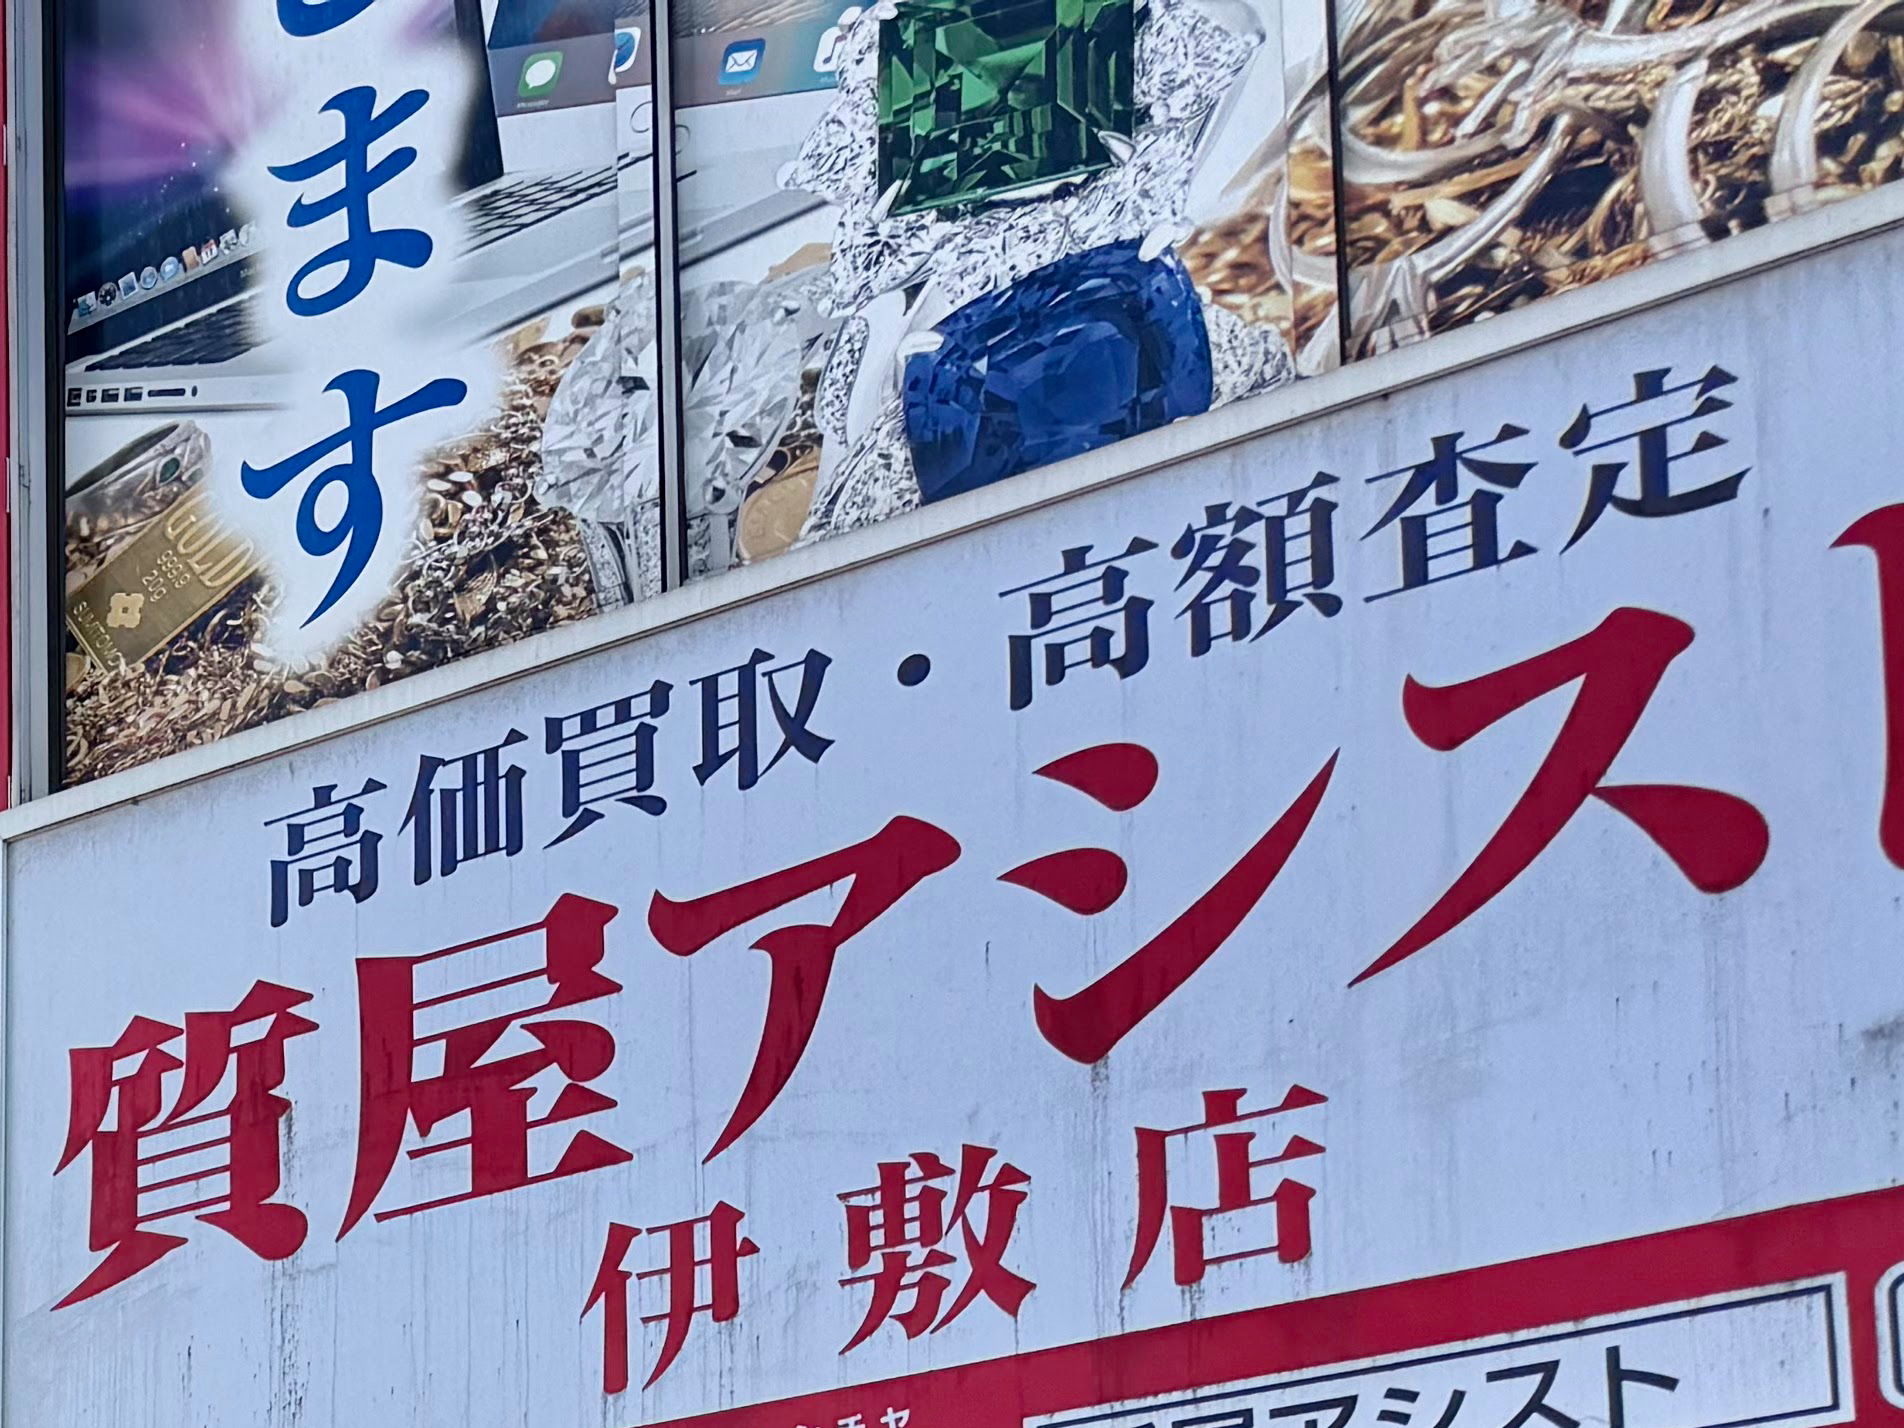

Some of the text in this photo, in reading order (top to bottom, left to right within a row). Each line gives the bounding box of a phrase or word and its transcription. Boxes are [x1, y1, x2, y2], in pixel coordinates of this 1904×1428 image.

[240, 0, 467, 628] ます
[264, 364, 1753, 929] 高価買取・高額査定
[579, 1084, 1329, 1396] 伊敷店
